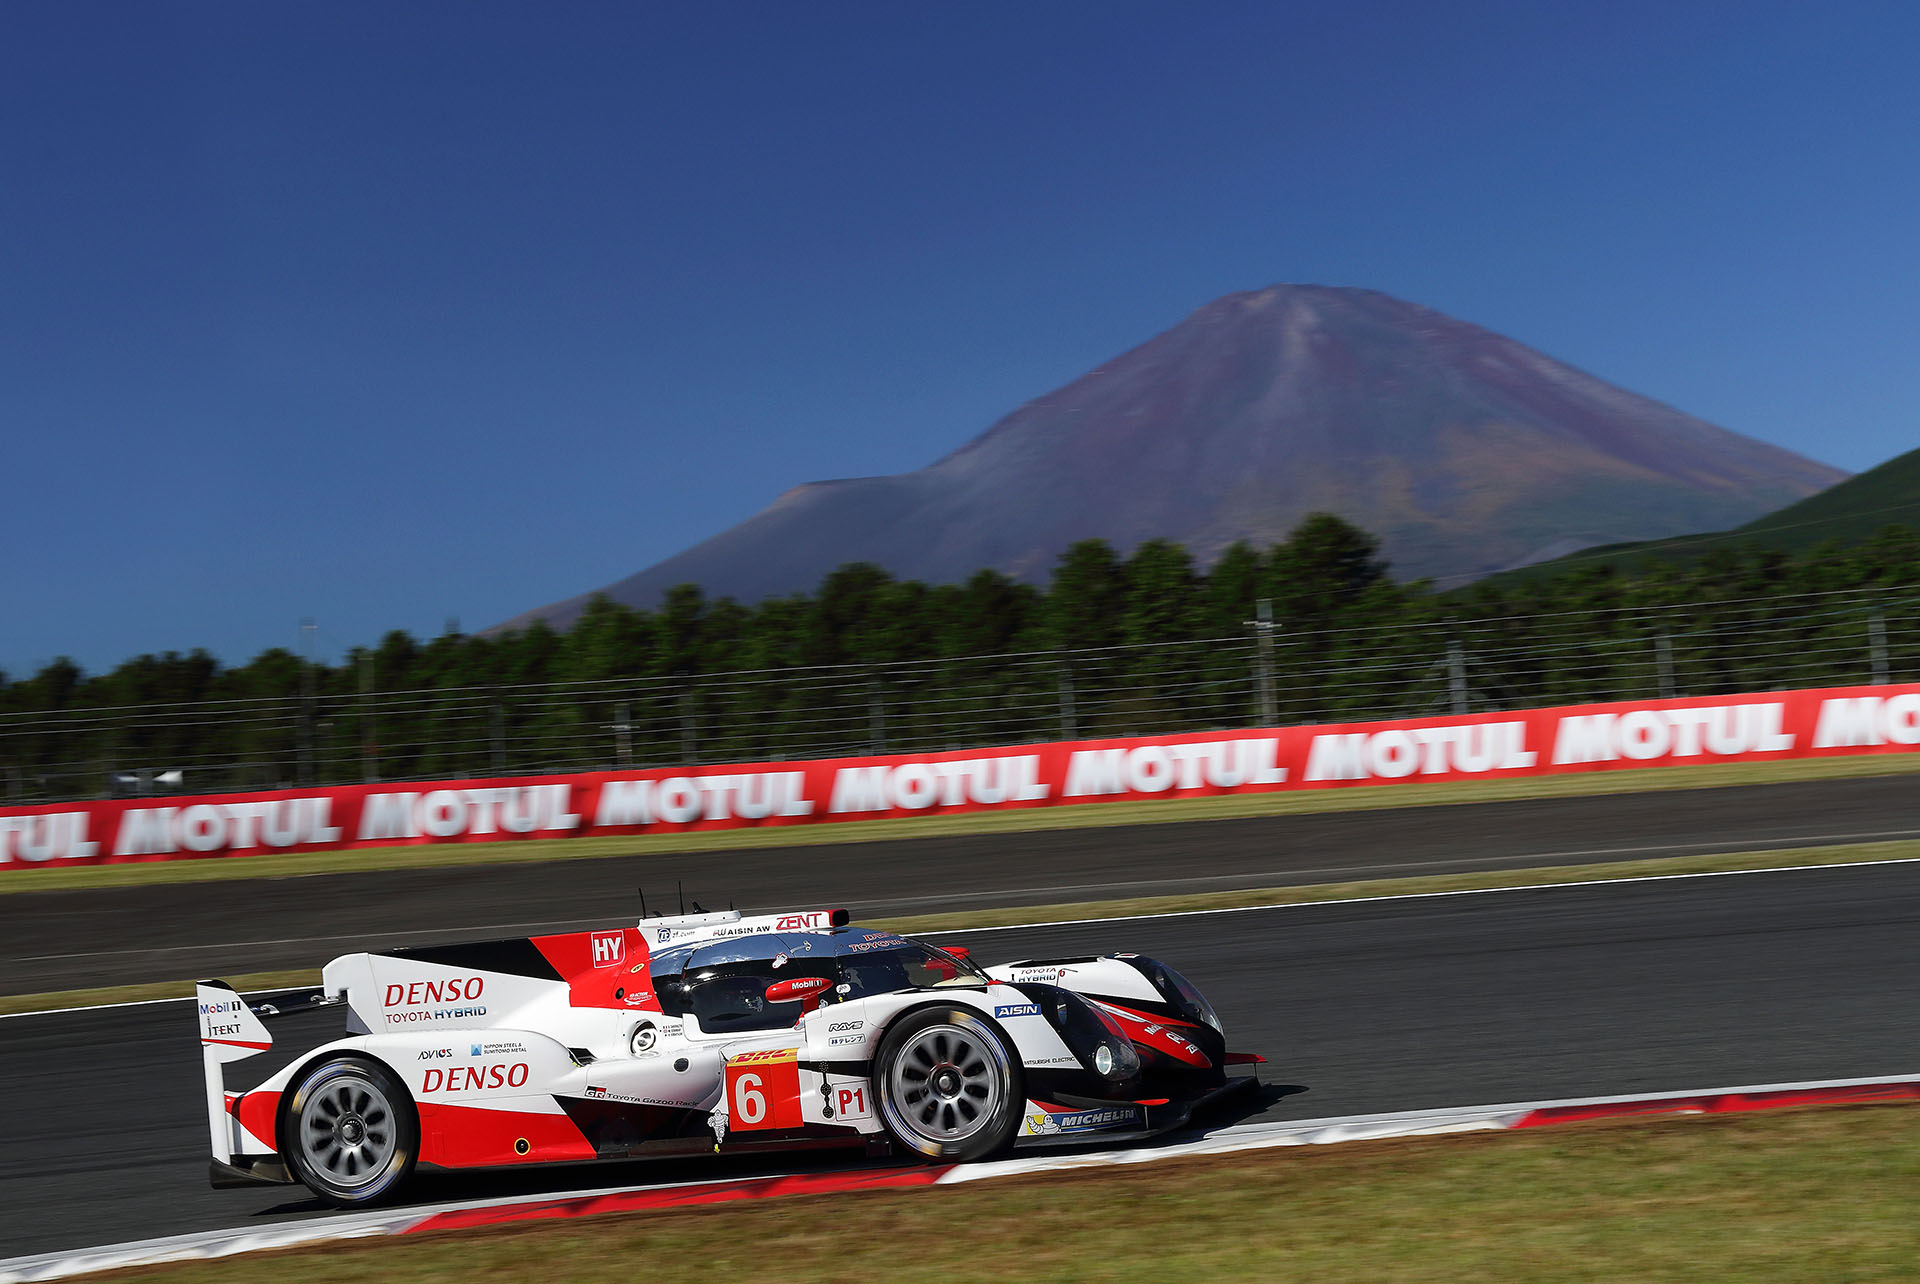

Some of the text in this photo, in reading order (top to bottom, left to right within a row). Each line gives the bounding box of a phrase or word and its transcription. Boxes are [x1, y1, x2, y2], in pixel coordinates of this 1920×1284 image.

[1551, 702, 1796, 766] MOTUL
[1303, 721, 1538, 781] MOTUL
[1063, 738, 1289, 797] MOTUL
[828, 754, 1050, 813] MOTUL
[593, 771, 814, 826] MOTUL
[357, 784, 581, 840] MOTUL
[112, 797, 343, 856] MOTUL
[728, 927, 754, 936] AISIN
[756, 925, 771, 934] AW
[776, 913, 822, 930] ZENT
[594, 937, 621, 962] HY
[1018, 974, 1056, 982] HYBRID
[1020, 967, 1056, 975] TOYOTA
[384, 977, 484, 1007] DENSO
[791, 980, 814, 990] Mobil
[200, 1002, 229, 1014] Mobil
[385, 1006, 487, 1024] TOYOTA HYBRID
[998, 1005, 1038, 1016] AISIN
[829, 1020, 864, 1032] RAYS
[418, 1048, 453, 1060] ADVICS
[735, 1050, 787, 1062] DHL
[422, 1063, 529, 1093] DENSO
[585, 1089, 606, 1099] GR
[607, 1093, 641, 1103] TOYOTA
[735, 1073, 766, 1124] 6
[838, 1088, 865, 1115] P1
[1061, 1109, 1134, 1126] MICHELIN
